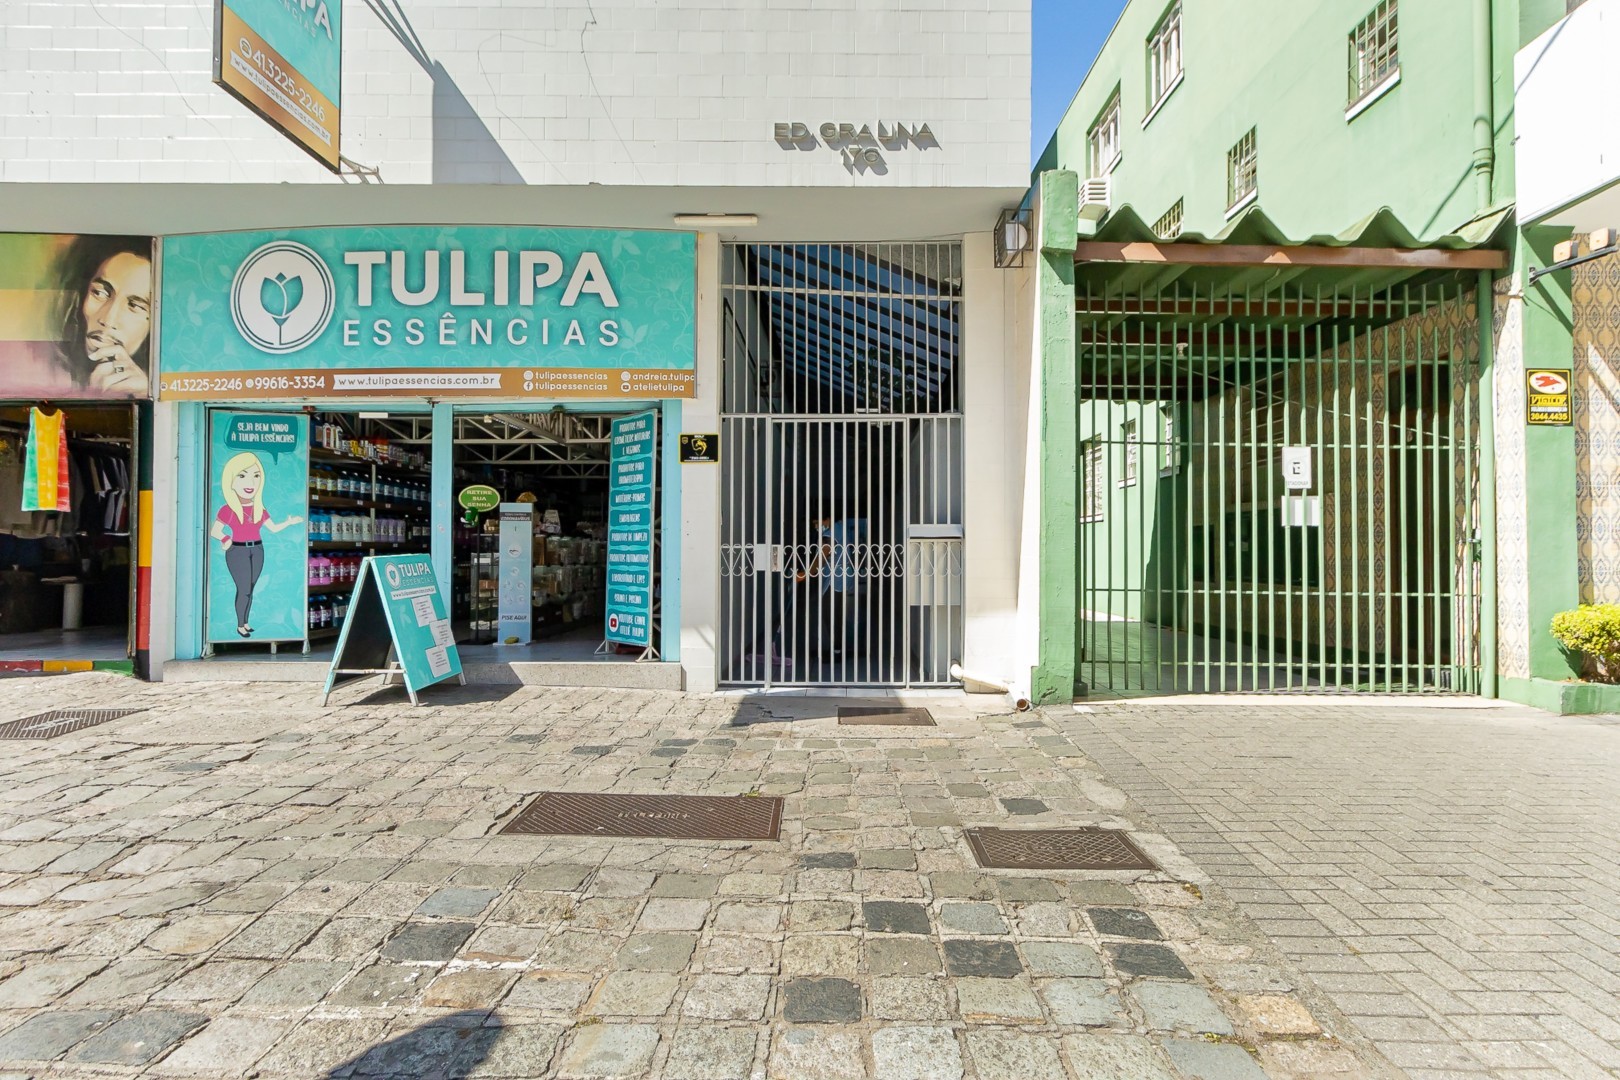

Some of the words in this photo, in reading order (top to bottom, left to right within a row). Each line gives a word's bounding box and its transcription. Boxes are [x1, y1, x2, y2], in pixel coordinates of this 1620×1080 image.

[234, 58, 329, 140] www.tulipaessencias.com.br
[344, 250, 620, 307] TULIPA
[343, 312, 619, 347] ESSÊNCIAS
[170, 378, 242, 392] 41.3225-2246
[255, 375, 325, 390] 99616-3354
[338, 376, 495, 387] www.tulipaessencias.com.br
[535, 371, 608, 381] tulipaessencias
[535, 382, 608, 391] tulipaessencias
[633, 382, 685, 392] atelietulipa
[237, 422, 253, 431] SEJA
[254, 423, 269, 432] BEM
[271, 423, 289, 432] VINDO
[239, 433, 259, 442] TULIPA
[398, 562, 431, 577] TULIPA
